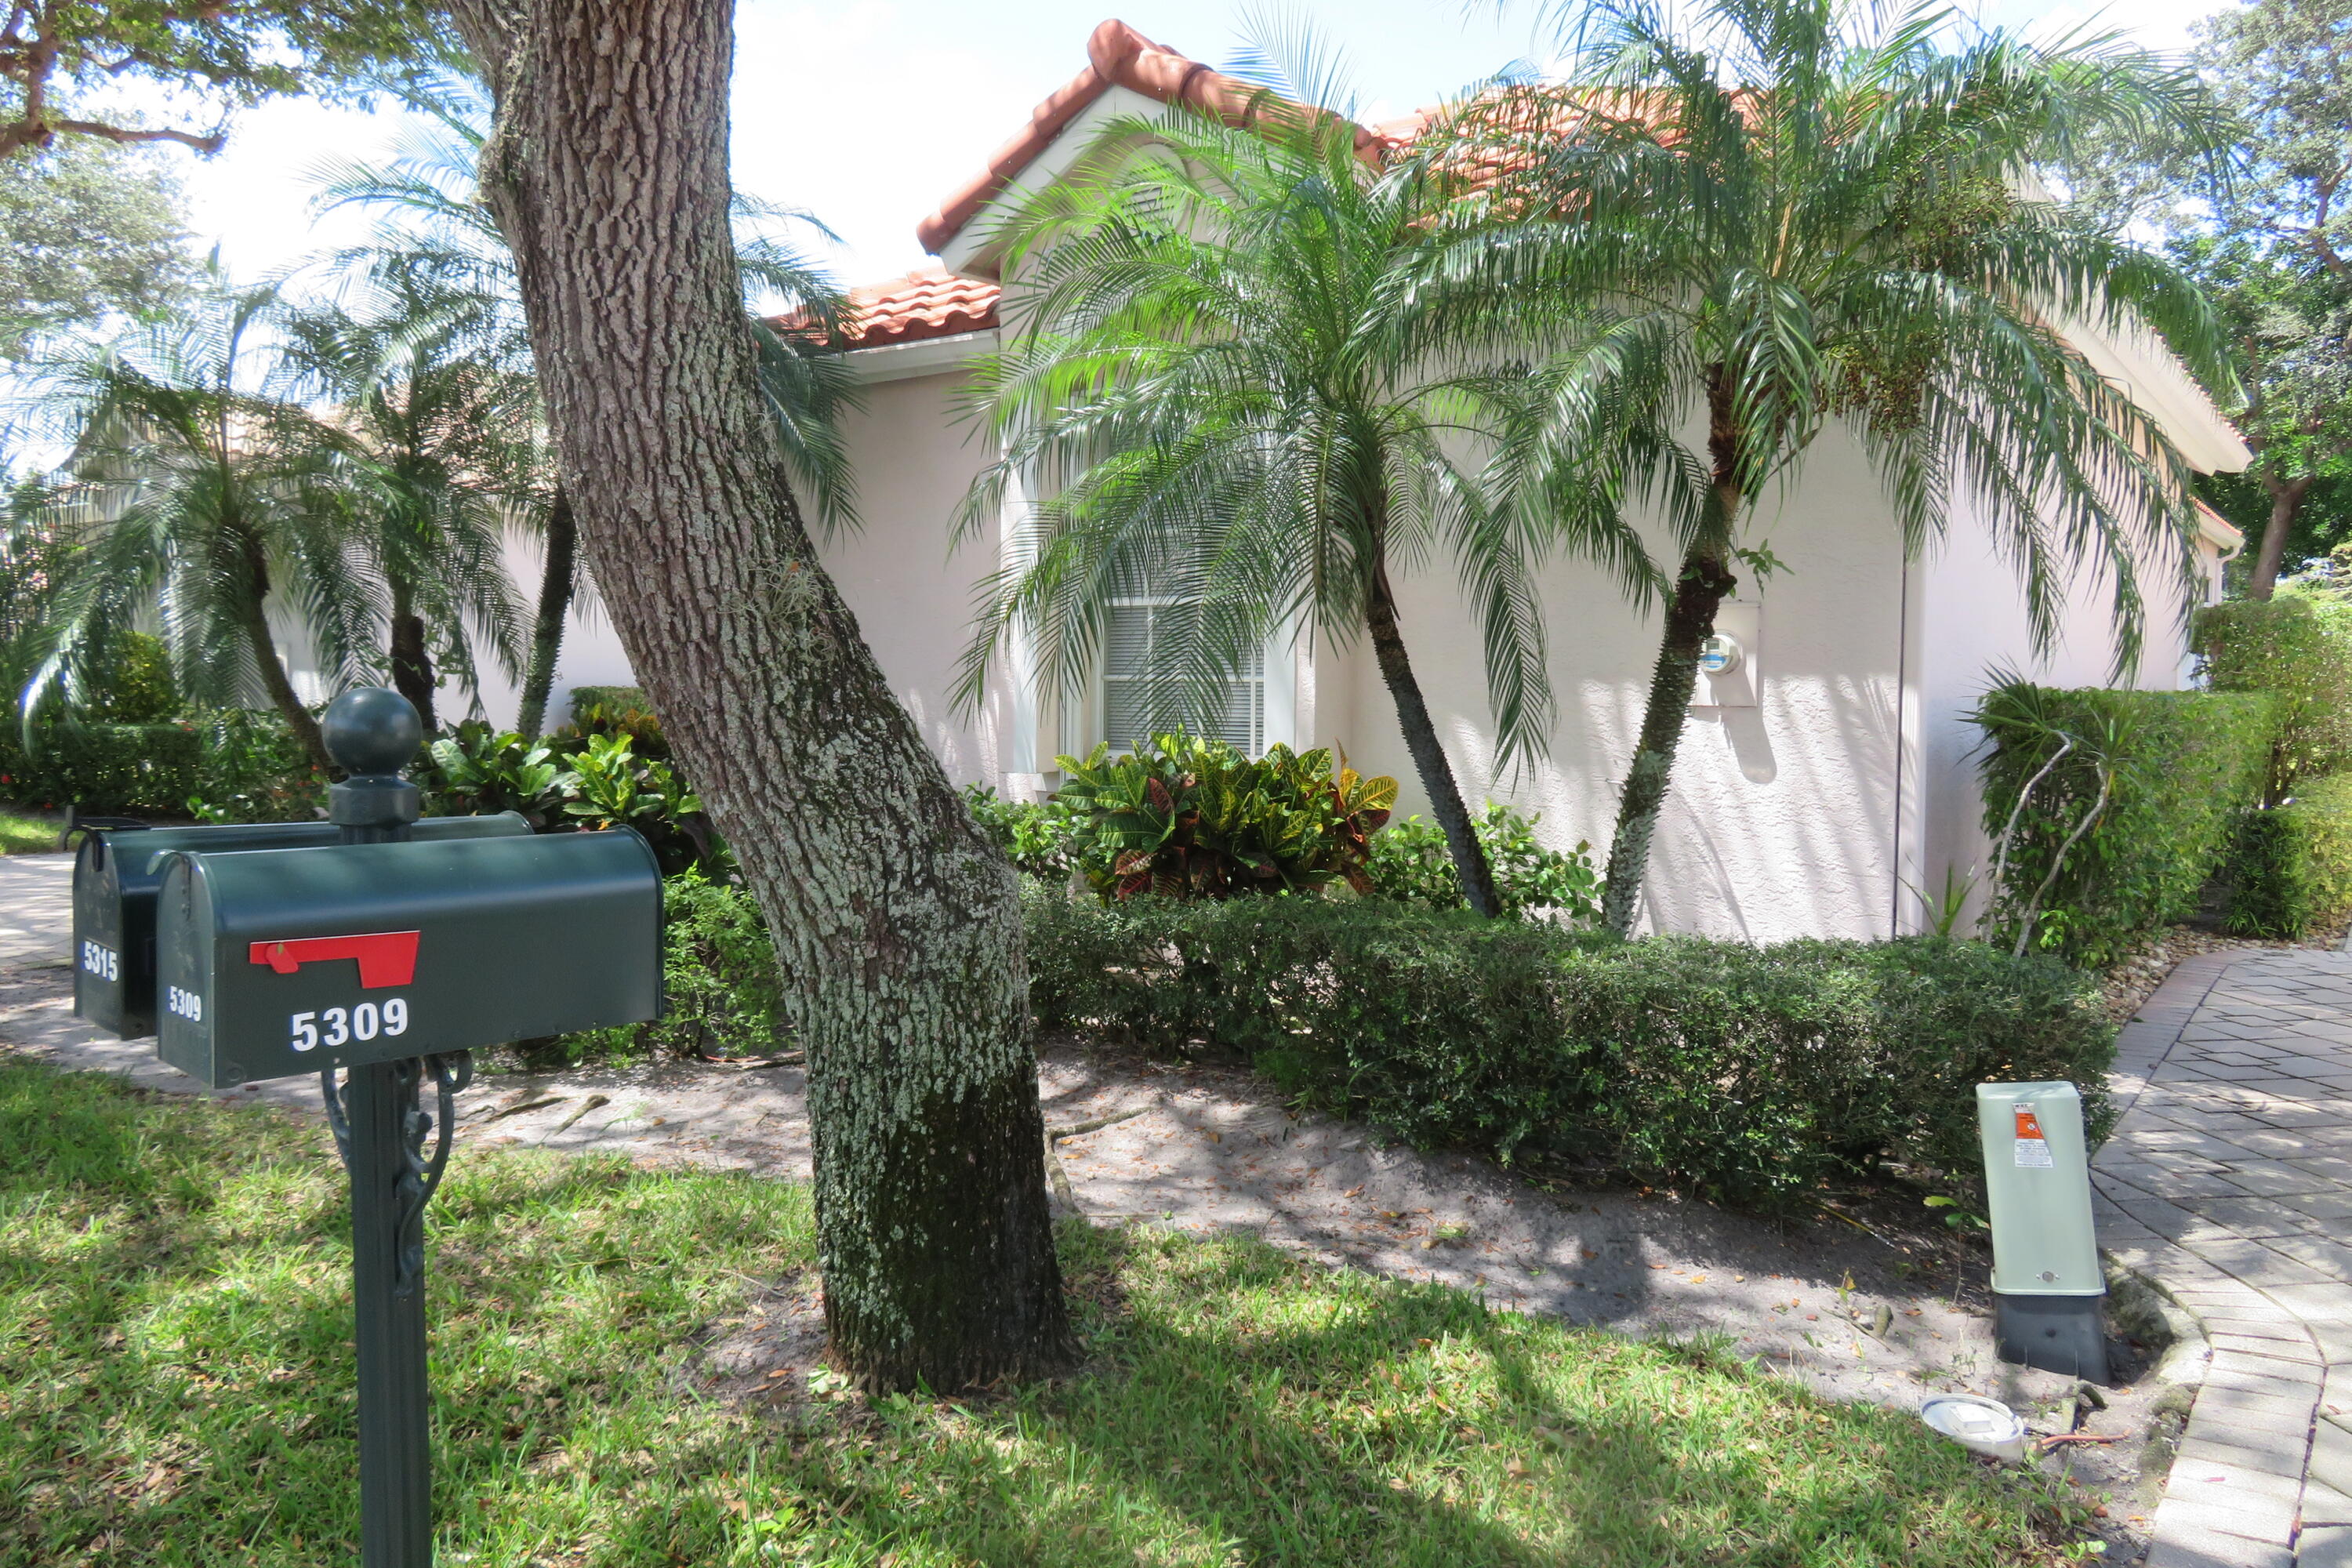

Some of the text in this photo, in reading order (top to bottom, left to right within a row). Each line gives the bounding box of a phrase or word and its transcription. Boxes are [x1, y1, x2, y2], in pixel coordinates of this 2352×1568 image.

[82, 940, 118, 982] 5315
[169, 985, 202, 1022] 5309
[291, 998, 408, 1052] 5309
